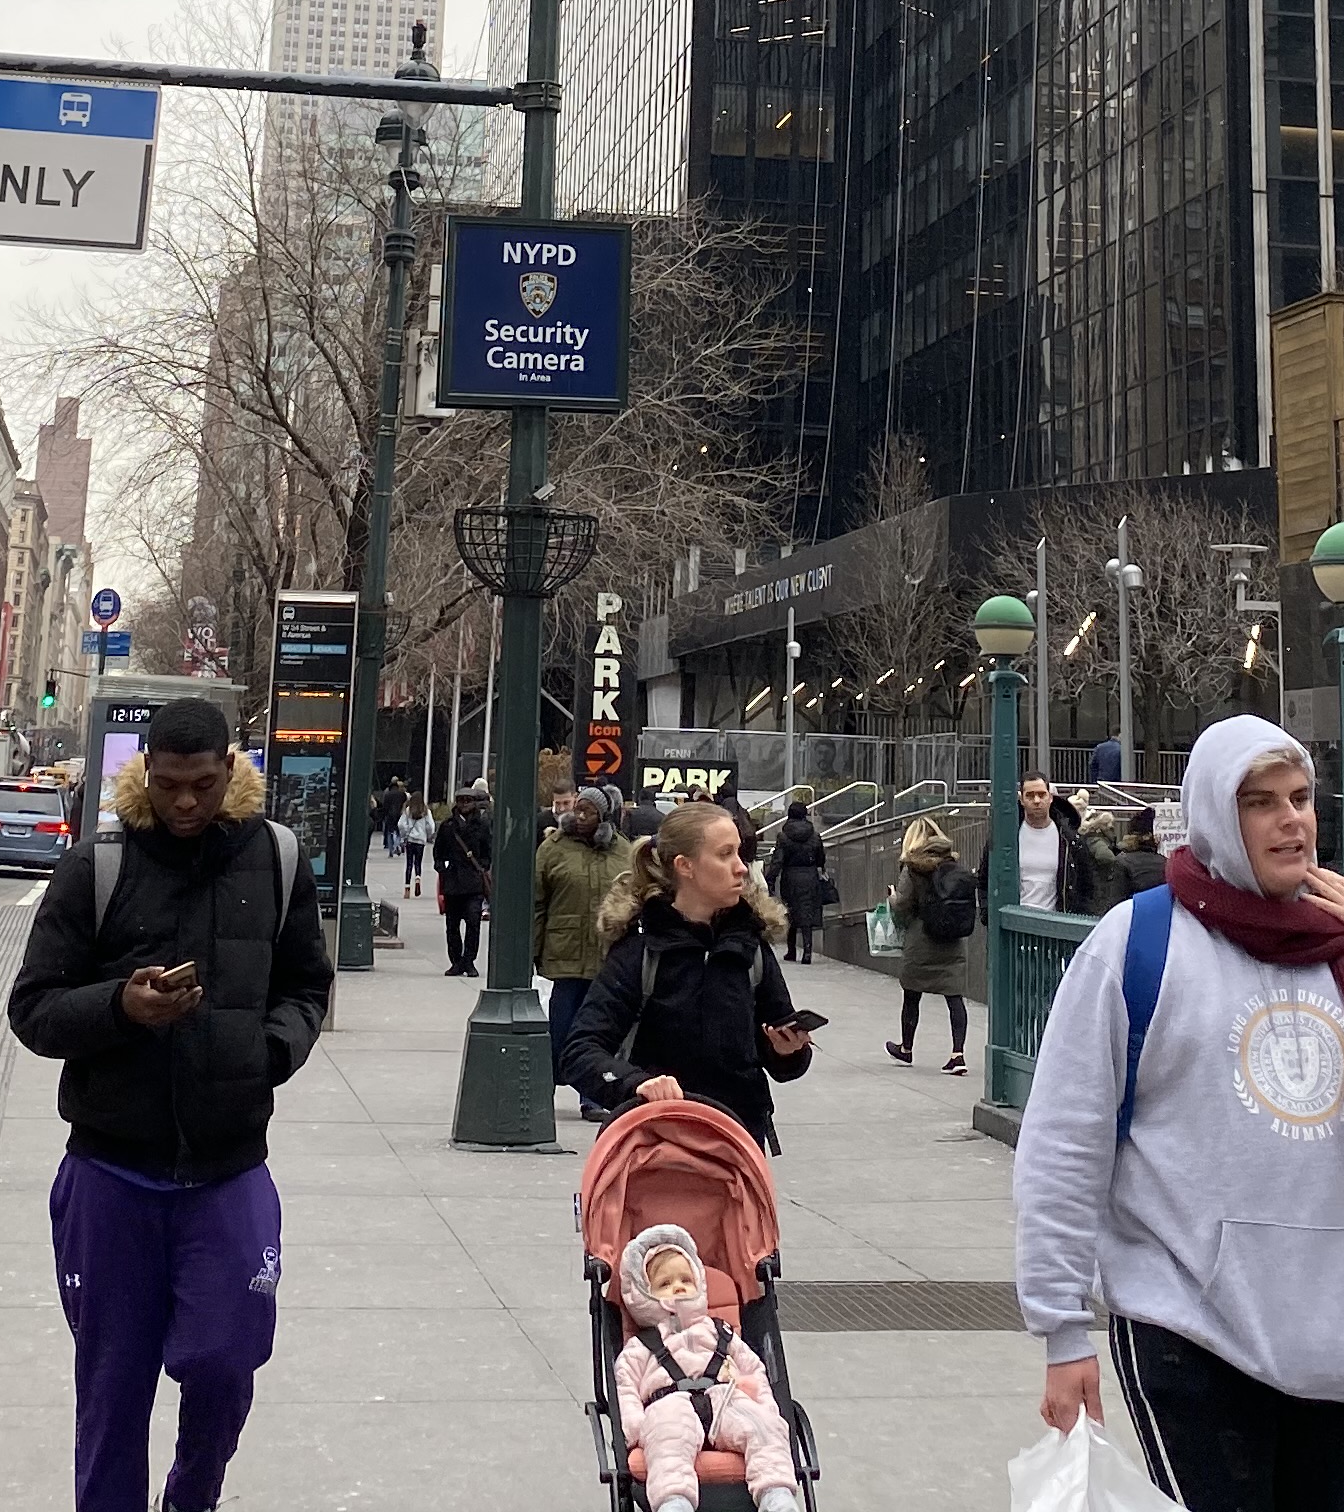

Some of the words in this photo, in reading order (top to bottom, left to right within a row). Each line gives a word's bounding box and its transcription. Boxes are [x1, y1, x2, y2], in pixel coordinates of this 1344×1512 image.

[502, 241, 577, 266] NYPD
[484, 319, 590, 351] Security
[486, 346, 585, 372] Camera
[518, 372, 530, 382] In
[530, 373, 552, 383] Area
[775, 577, 789, 603] OUR
[790, 573, 807, 597] NEW
[807, 563, 833, 593] CLIENT
[300, 624, 320, 632] Street
[592, 592, 623, 722] PARK
[663, 748, 691, 759] PENN
[642, 766, 732, 795] PARK
[1226, 1013, 1248, 1055] LONG
[1269, 1117, 1335, 1142] ALUMNI
